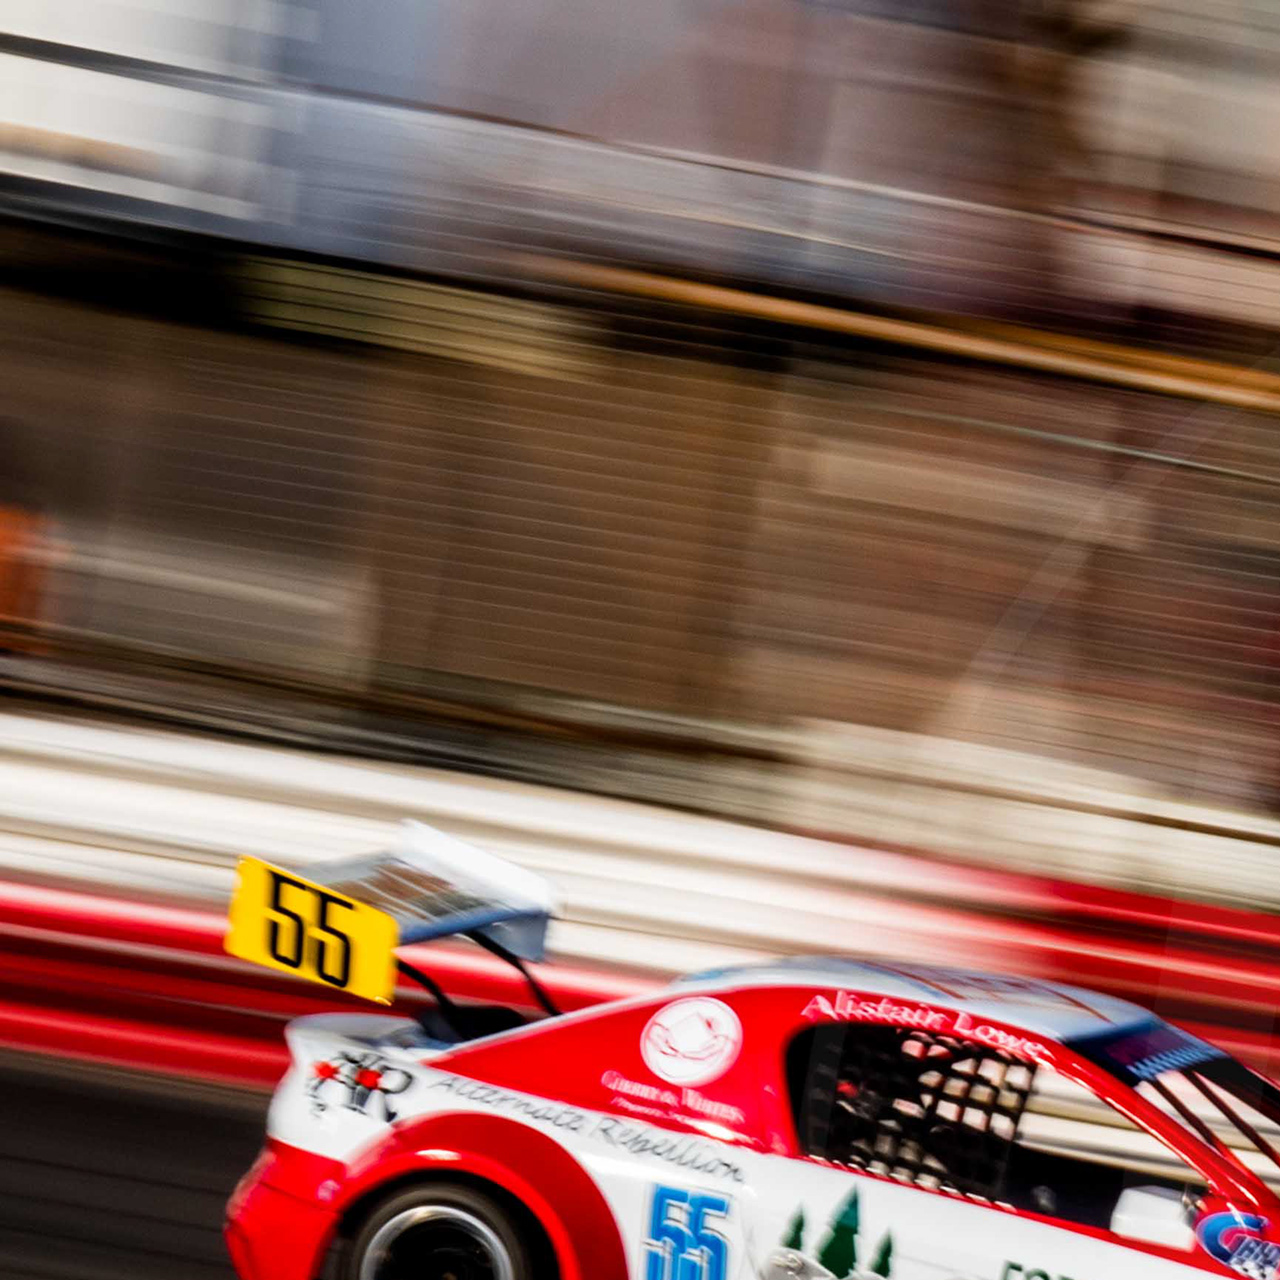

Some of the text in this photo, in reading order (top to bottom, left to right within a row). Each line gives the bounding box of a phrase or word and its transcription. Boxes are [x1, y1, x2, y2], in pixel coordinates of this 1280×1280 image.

[265, 868, 353, 989] 55
[801, 990, 1057, 1060] Alistair Lowe
[428, 1075, 581, 1132] Alternate
[590, 1117, 745, 1184] Rebellion
